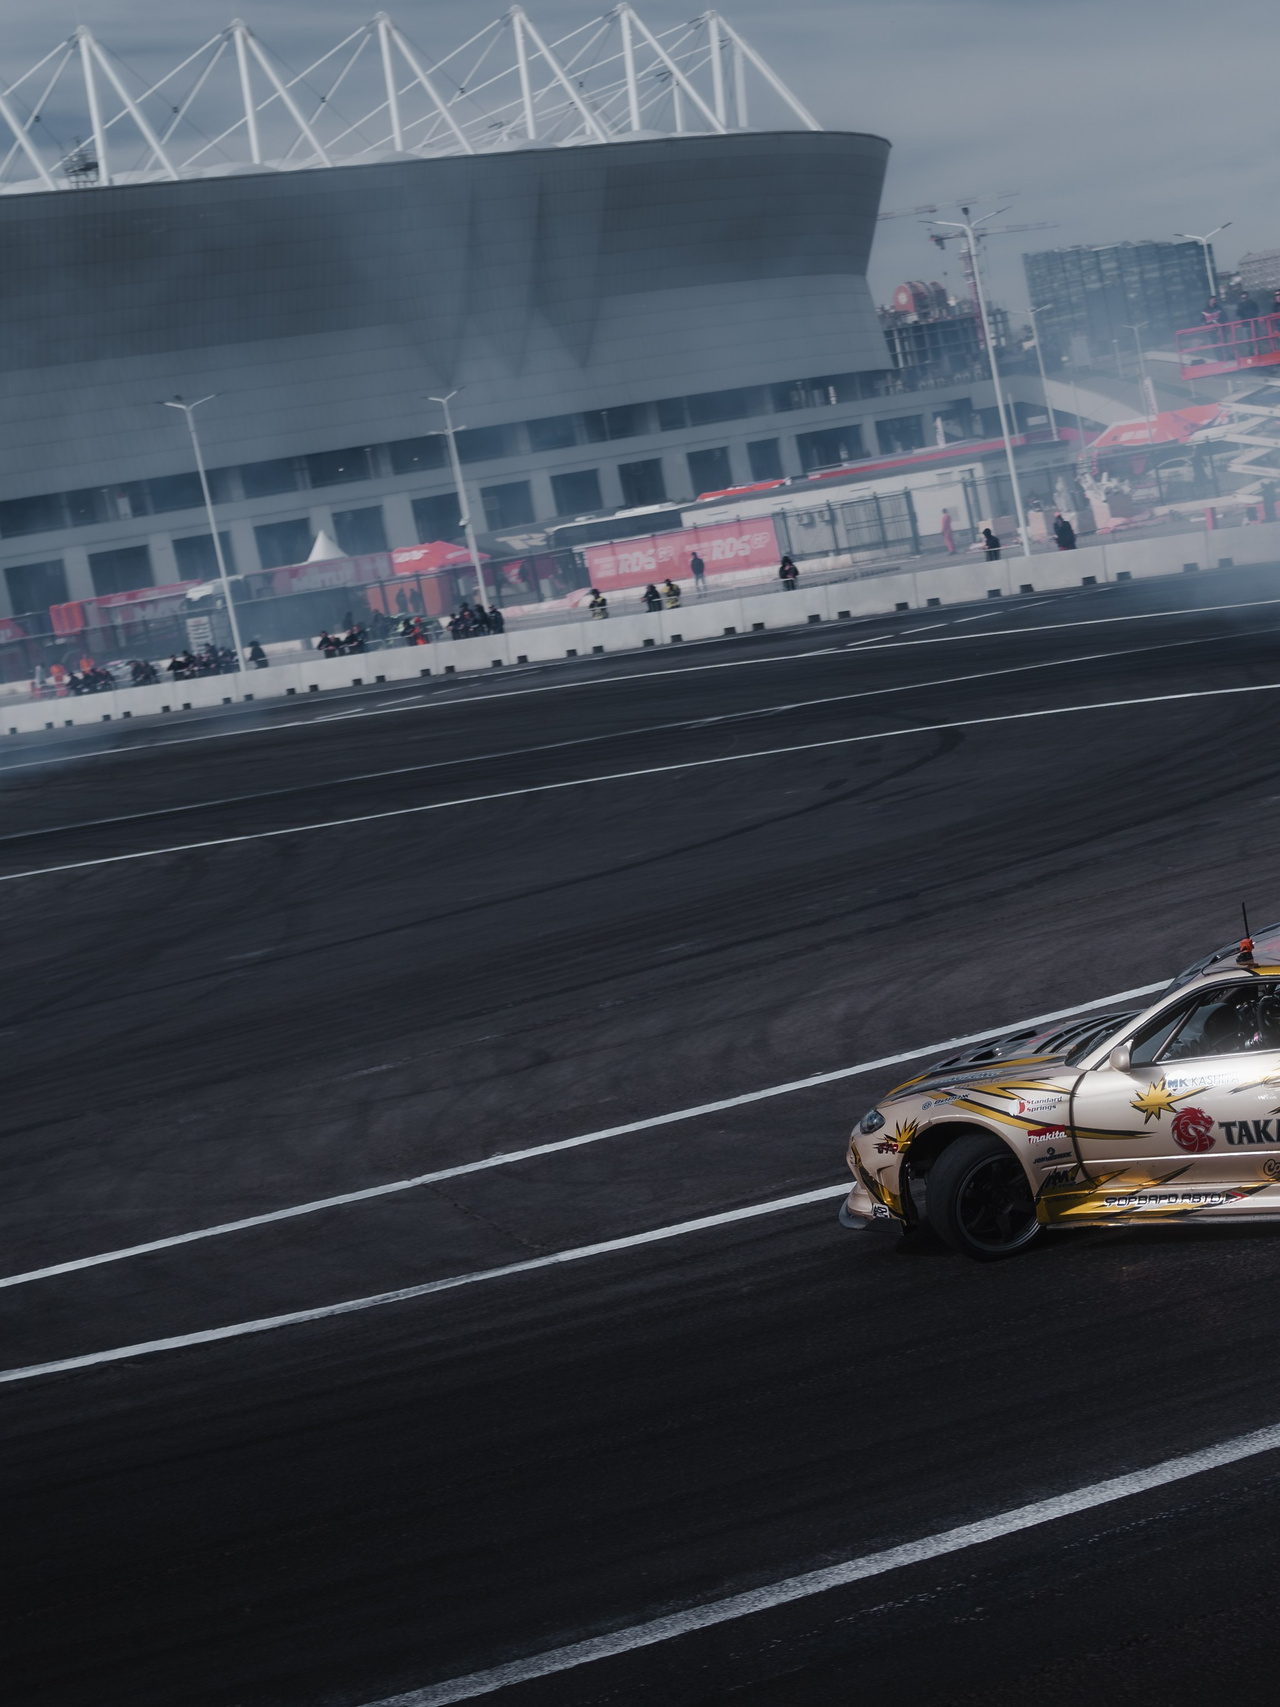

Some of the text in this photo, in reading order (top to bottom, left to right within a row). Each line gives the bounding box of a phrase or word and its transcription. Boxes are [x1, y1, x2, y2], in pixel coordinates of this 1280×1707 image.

[712, 535, 751, 560] RDS
[618, 549, 656, 574] RDS
[1167, 1078, 1189, 1088] MK
[1027, 1096, 1063, 1105] Standard
[1027, 1104, 1057, 1113] Springs
[1105, 1193, 1179, 1206] ФОРВАРД
